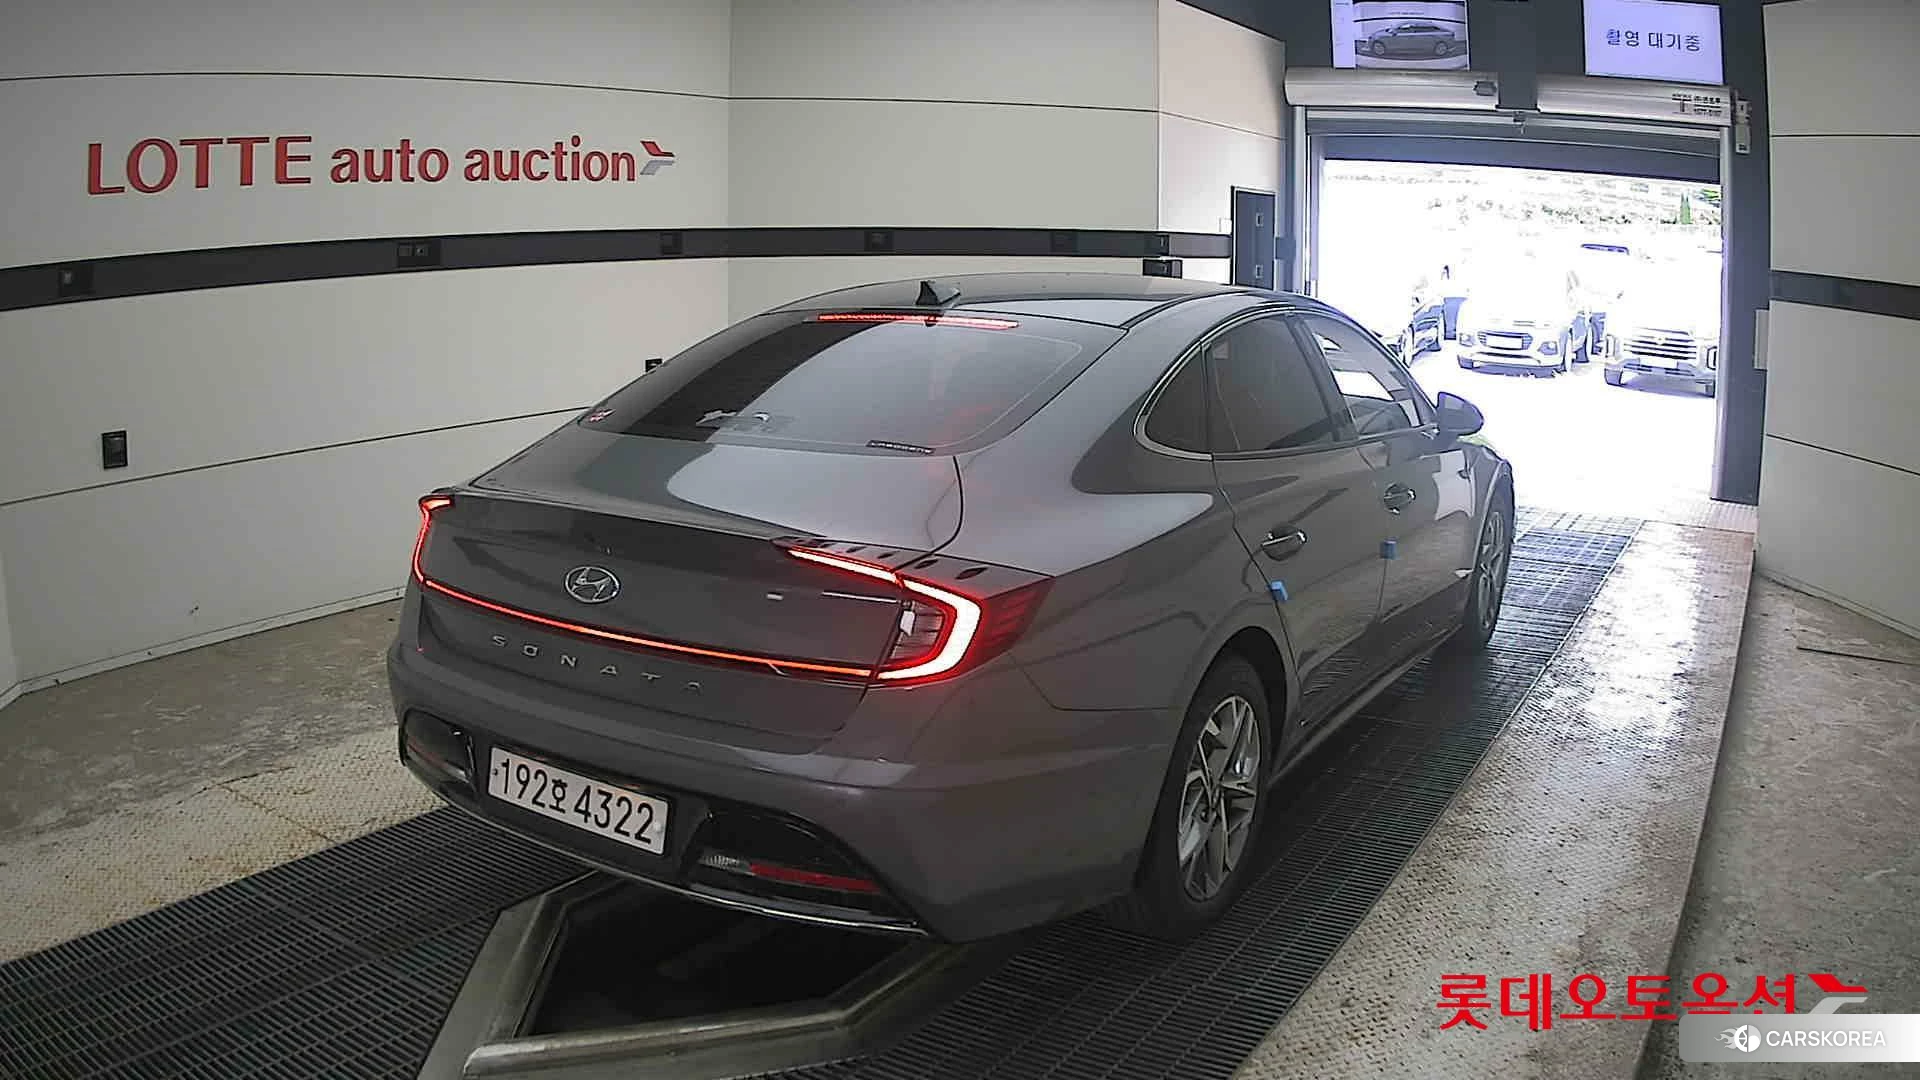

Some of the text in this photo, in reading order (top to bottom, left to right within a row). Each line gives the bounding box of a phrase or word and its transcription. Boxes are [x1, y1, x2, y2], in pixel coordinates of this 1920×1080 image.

[1648, 32, 1700, 51] 대기중
[88, 135, 636, 195] LOTTE auto auction
